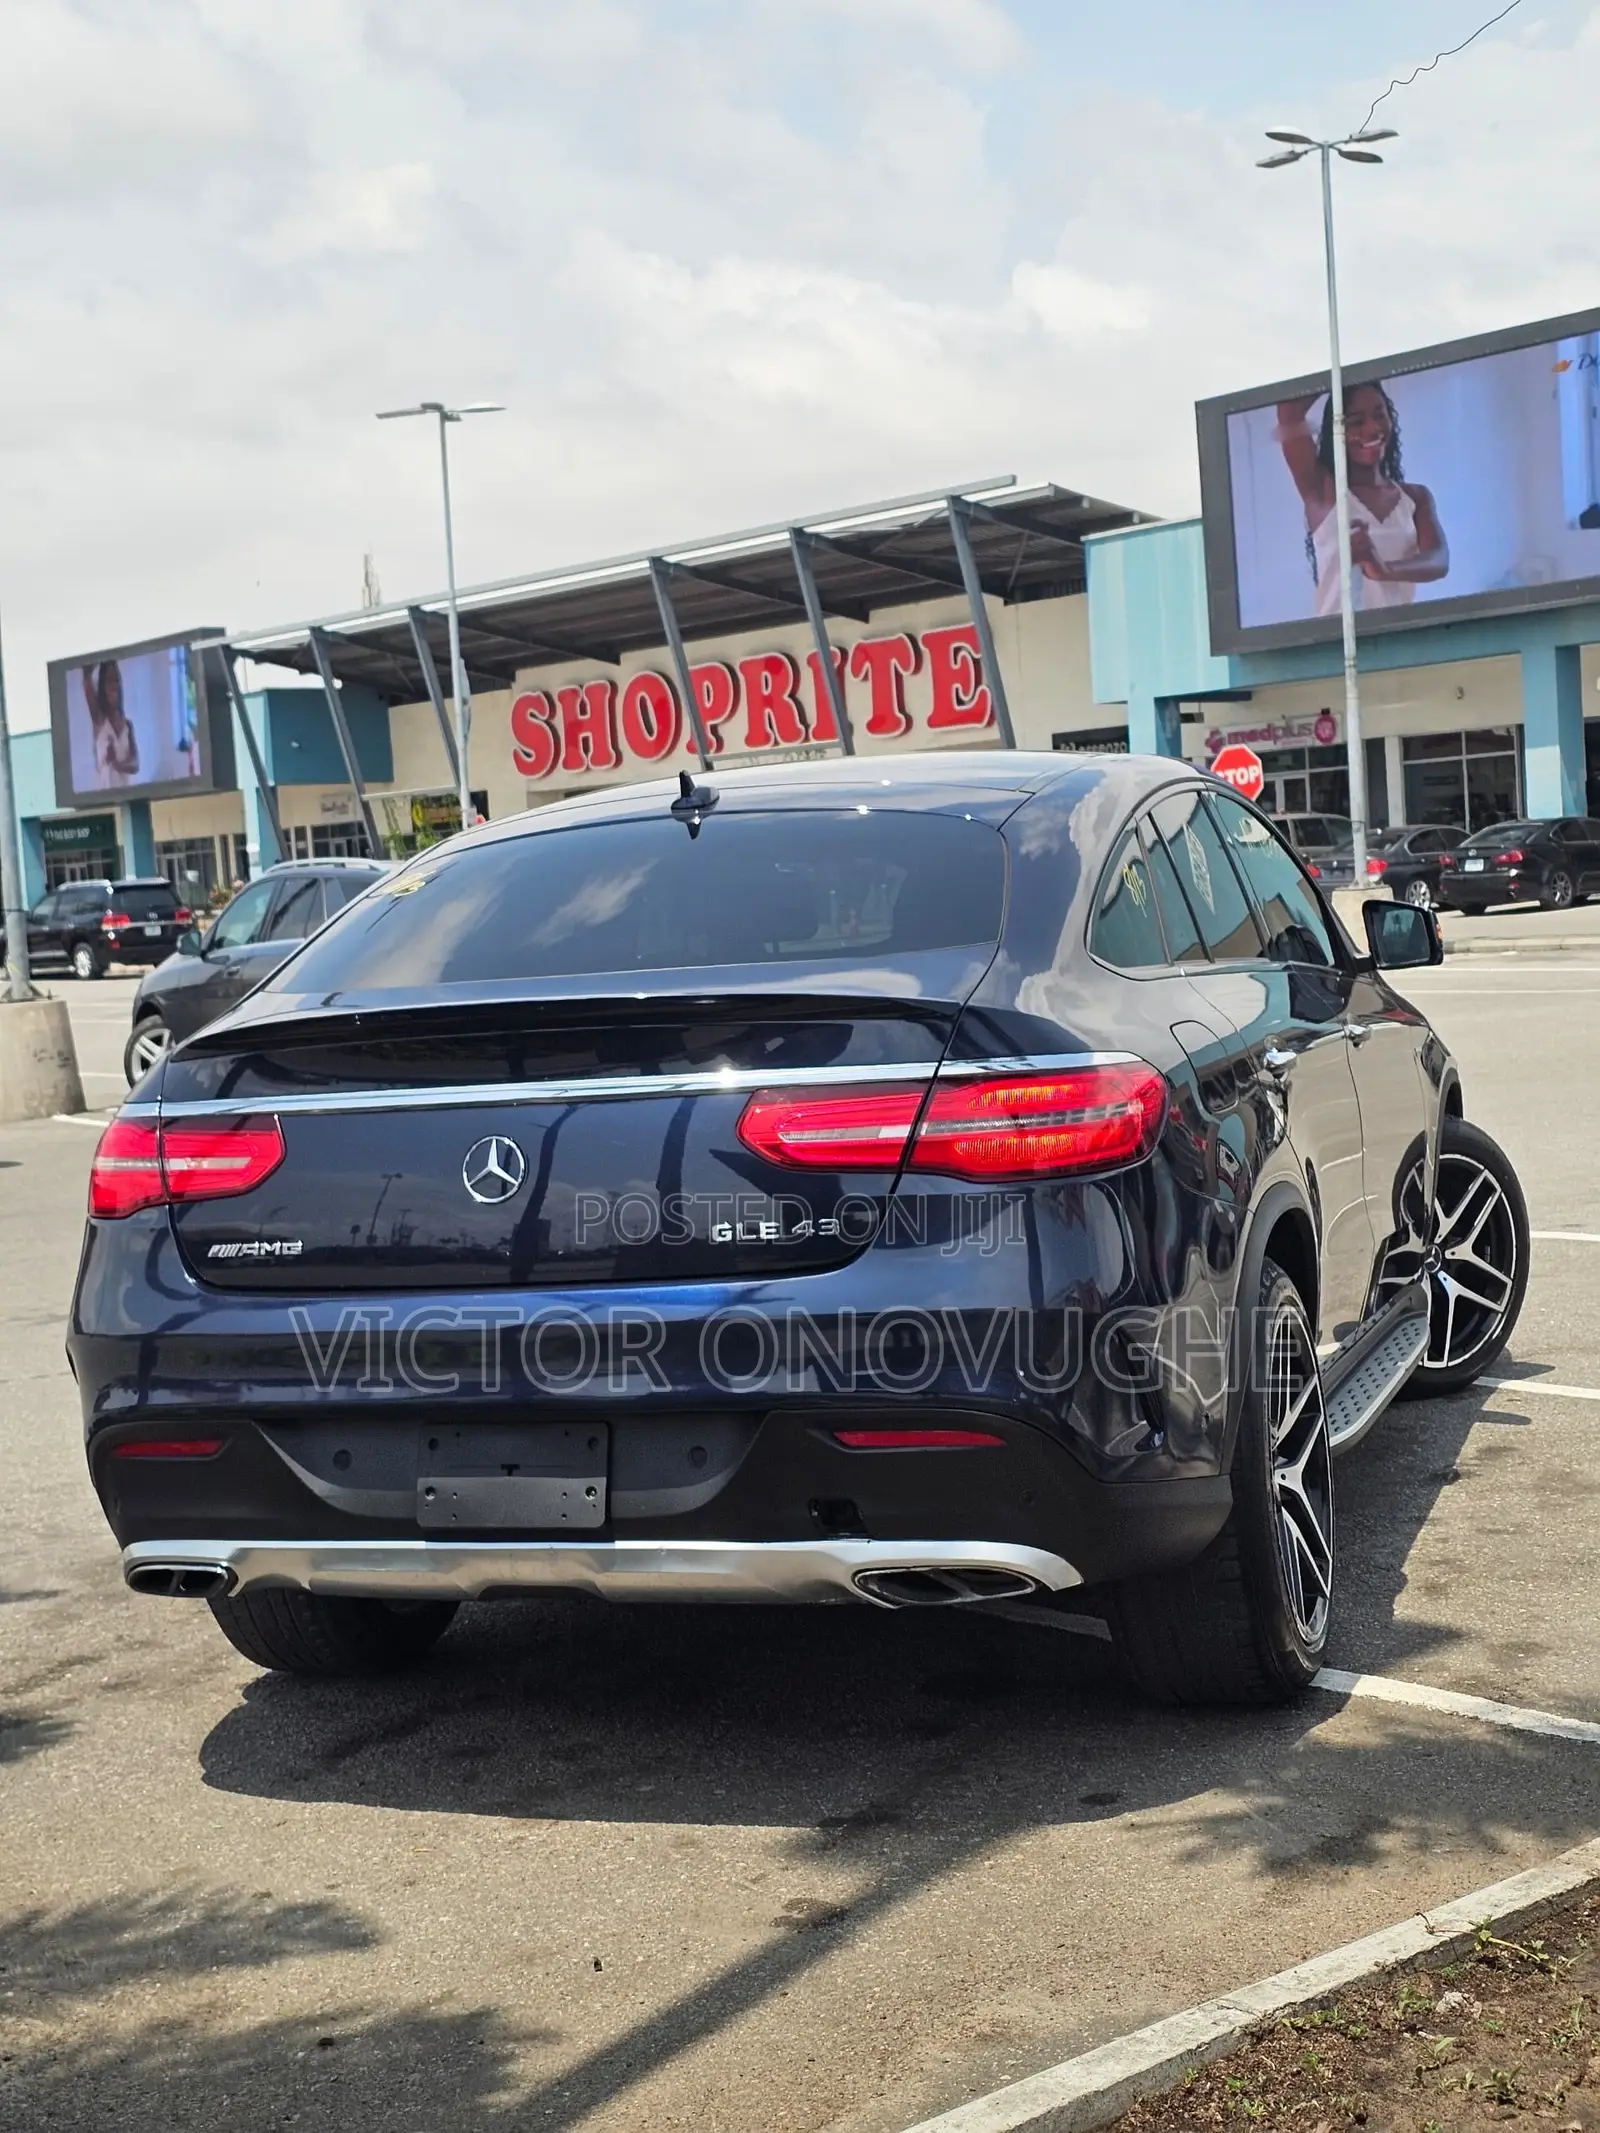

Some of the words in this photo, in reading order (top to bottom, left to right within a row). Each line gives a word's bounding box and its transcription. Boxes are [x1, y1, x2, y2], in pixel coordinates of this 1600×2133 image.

[510, 623, 994, 779] SHOPRITE
[1217, 765, 1260, 785] TOP
[711, 1220, 781, 1242] GLE
[791, 1218, 840, 1237] 43
